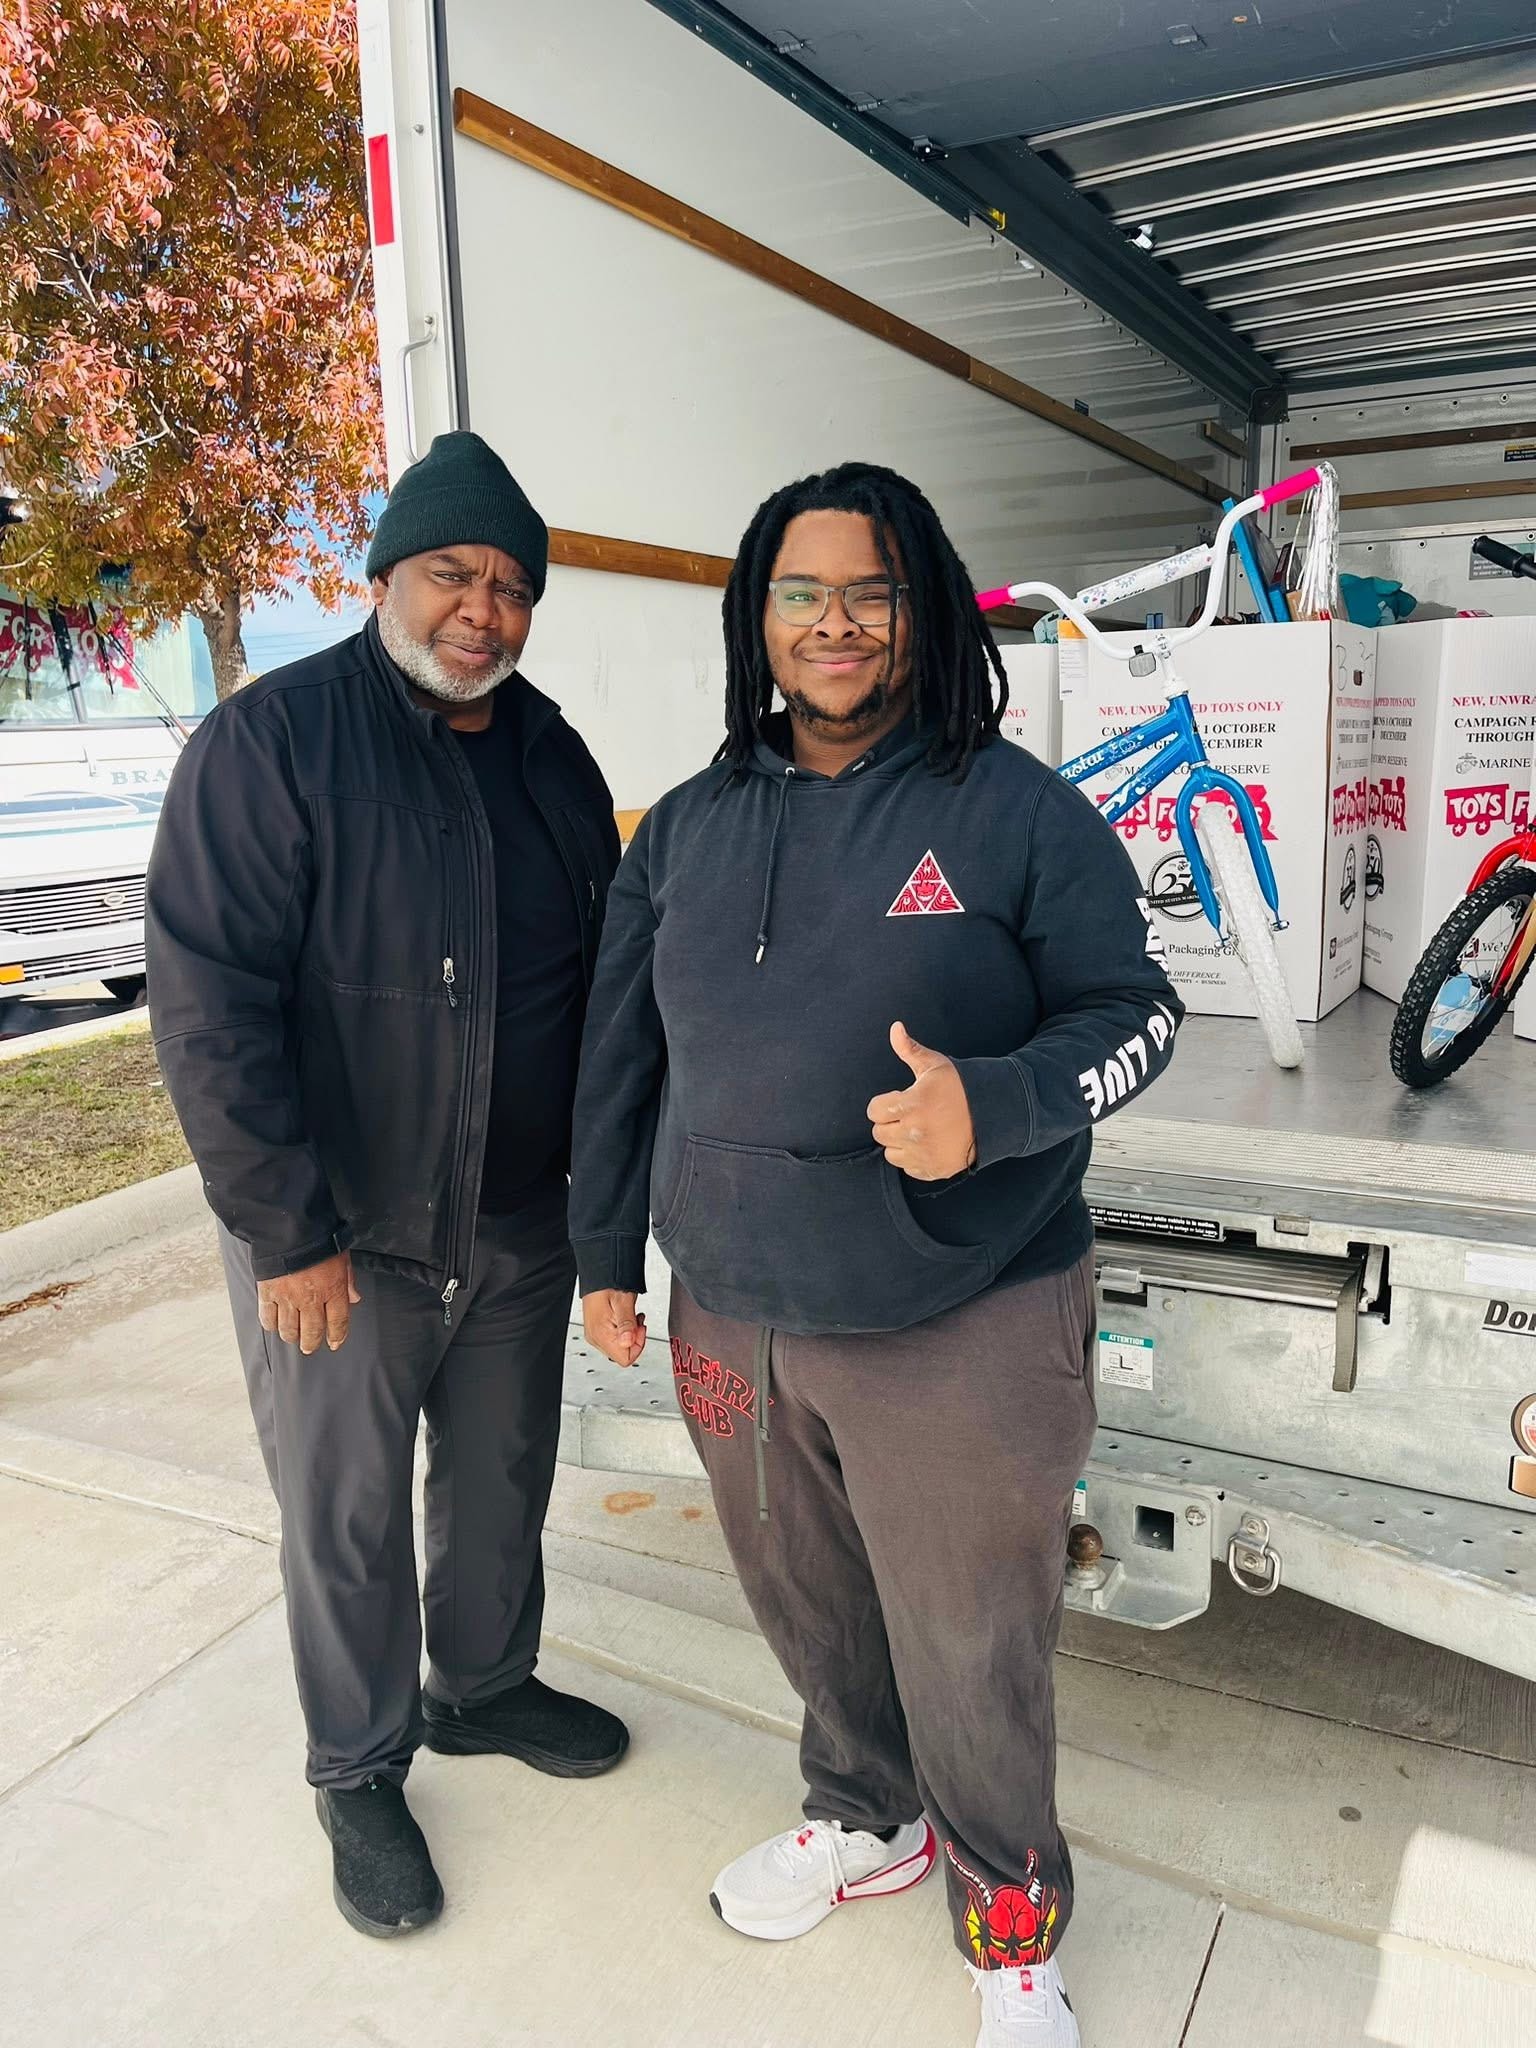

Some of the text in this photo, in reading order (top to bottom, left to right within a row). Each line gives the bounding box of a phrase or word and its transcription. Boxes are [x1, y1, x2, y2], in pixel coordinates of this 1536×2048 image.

[1130, 703, 1207, 716] UNWRED
[1211, 703, 1244, 713] TOYS
[1247, 701, 1284, 712] ONLY
[1454, 716, 1527, 728] CAMPAIGN
[1212, 723, 1277, 735] OCTOBER
[1466, 731, 1534, 743] THROUGH
[1203, 738, 1263, 750] ECEMBER
[1479, 758, 1531, 769] MARINE
[111, 769, 171, 785] BRA
[1383, 794, 1402, 818] TOTS
[1450, 792, 1502, 819] TOYS
[1169, 944, 1220, 957] Packaging
[1173, 970, 1221, 979] DIFFERENCE
[1078, 1035, 1149, 1119] LIVE
[1108, 1333, 1145, 1346] ATTENTION
